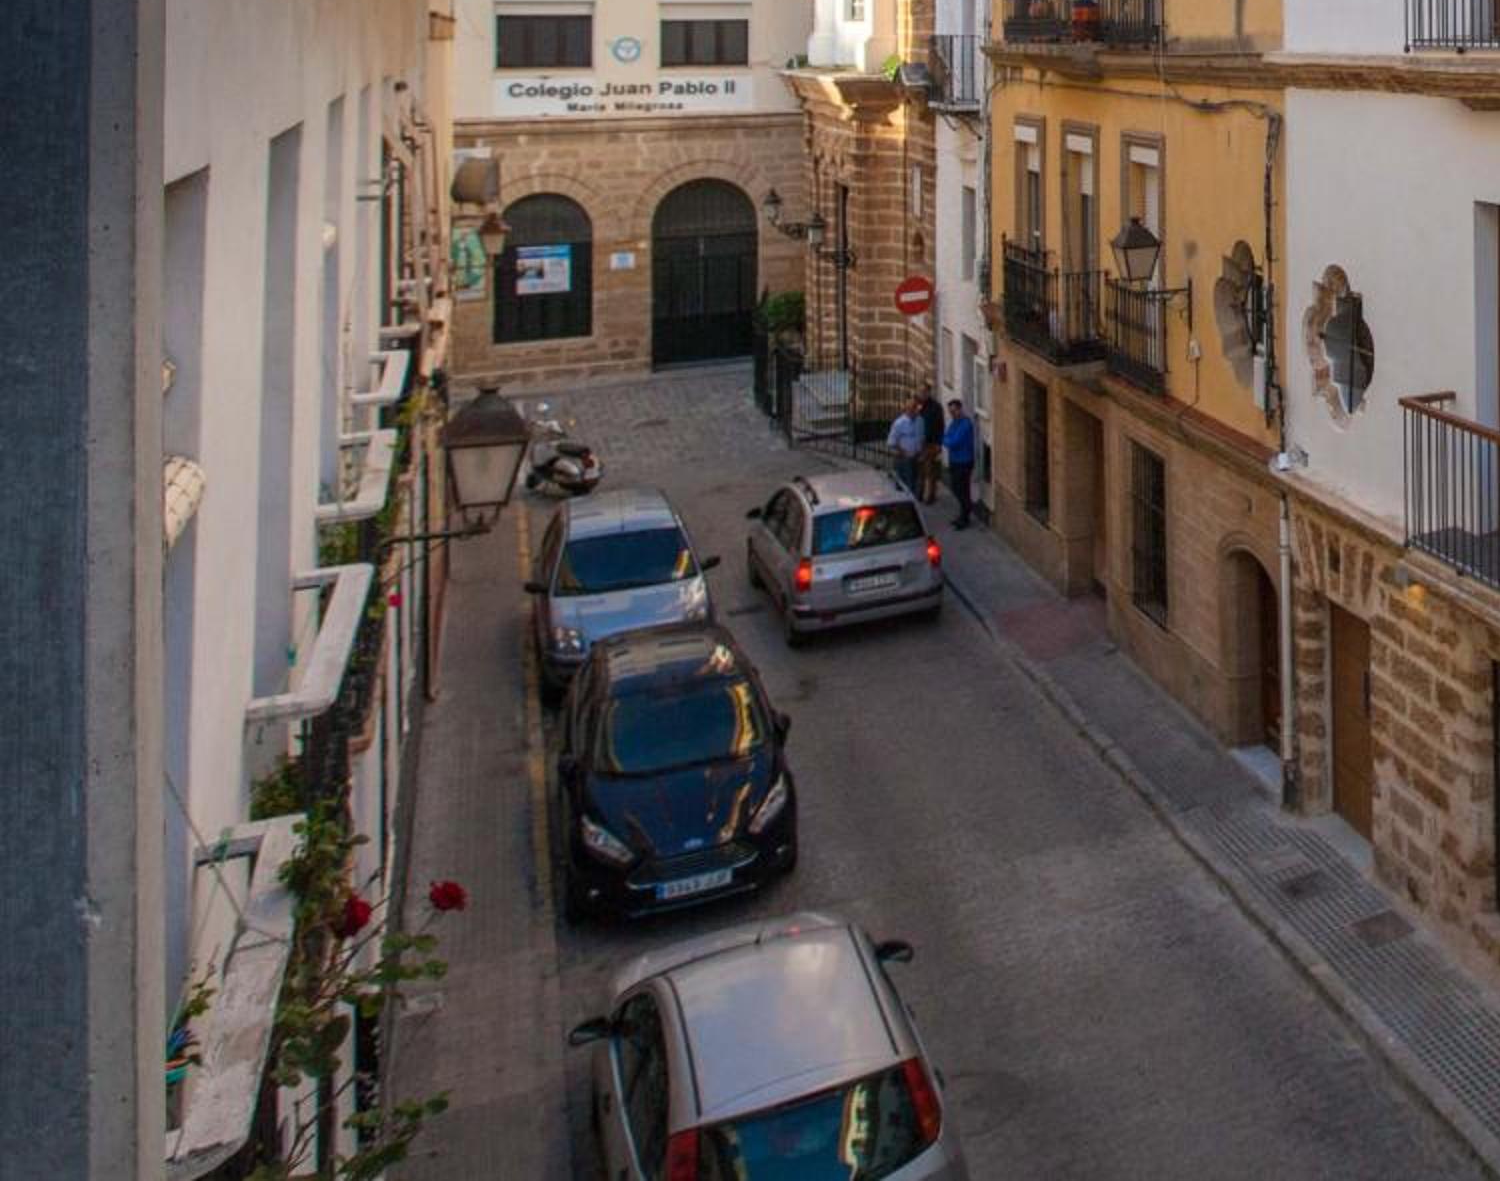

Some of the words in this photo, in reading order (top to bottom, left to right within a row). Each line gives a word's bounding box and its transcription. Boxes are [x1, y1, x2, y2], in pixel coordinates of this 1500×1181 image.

[508, 82, 593, 100] Colegio
[600, 82, 652, 97] Juan
[658, 80, 718, 95] Pablo
